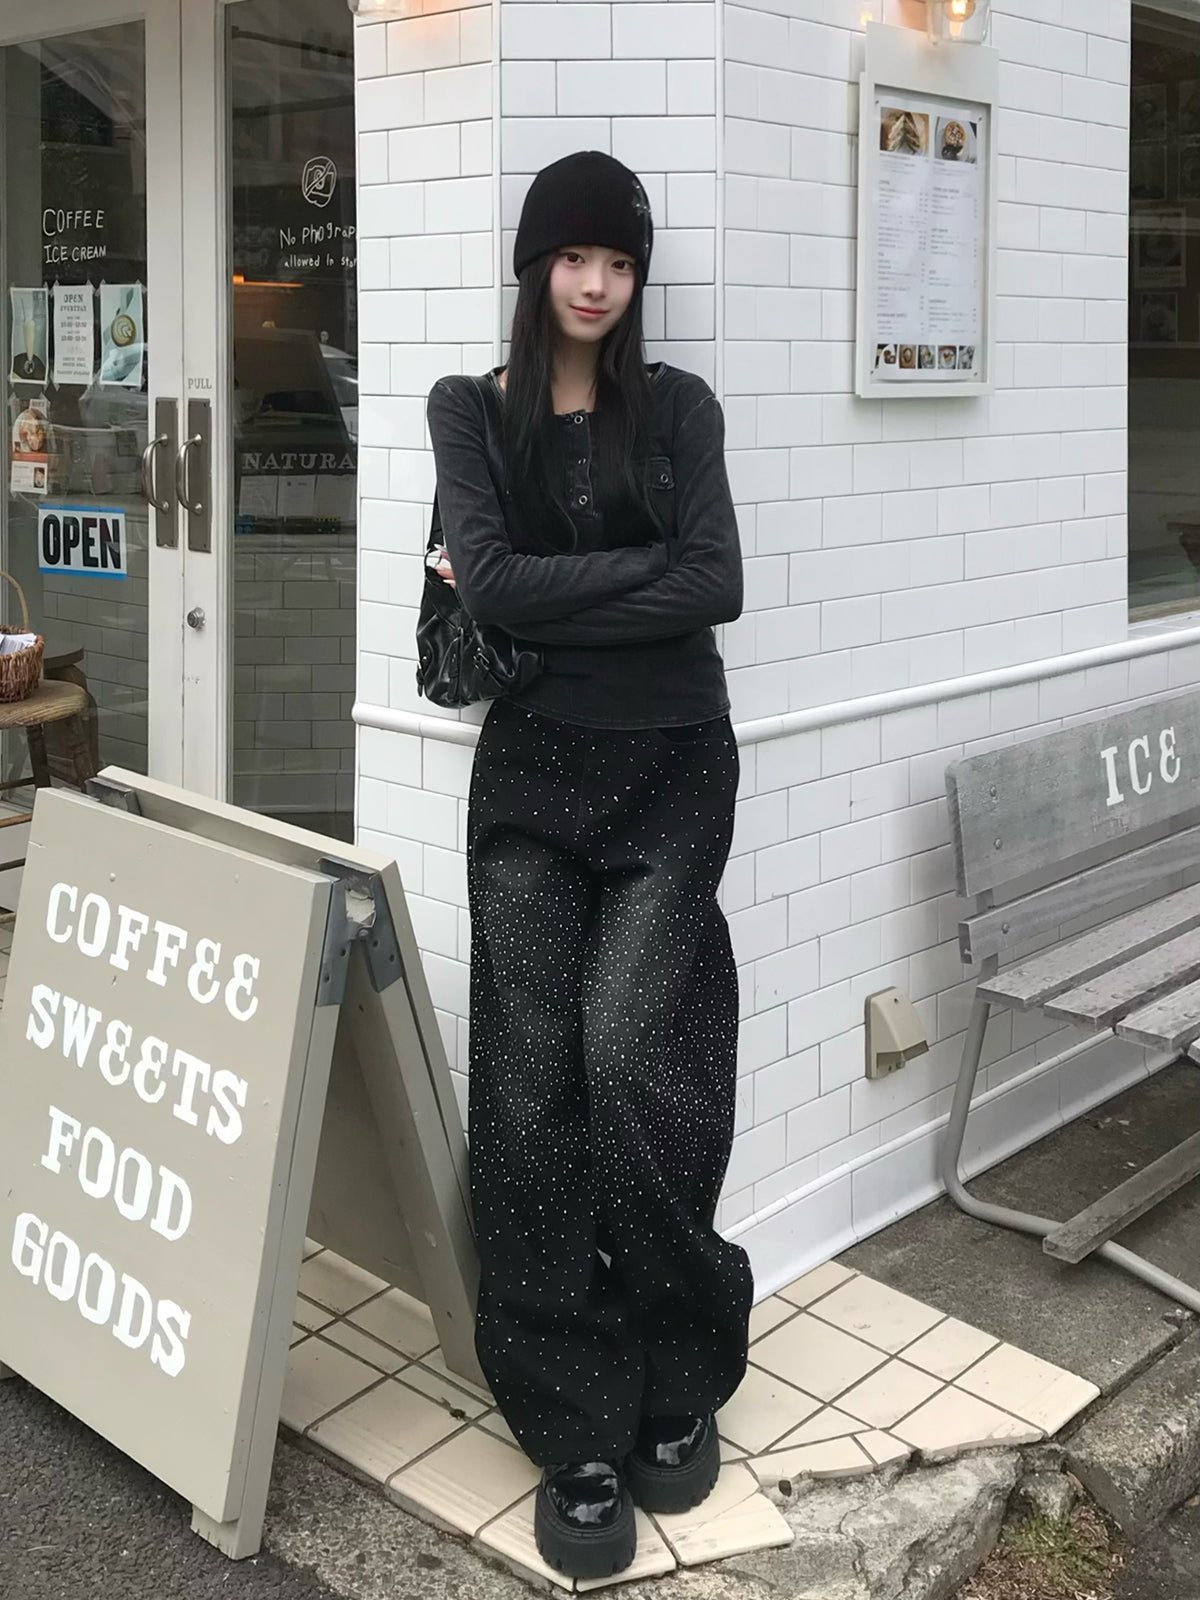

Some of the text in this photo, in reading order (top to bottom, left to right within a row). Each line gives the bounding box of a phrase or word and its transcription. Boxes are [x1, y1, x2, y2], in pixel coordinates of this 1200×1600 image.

[43, 208, 104, 236] COFFEE
[280, 227, 296, 248] No
[44, 244, 68, 263] ICE
[284, 254, 320, 268] allowed
[64, 294, 83, 303] OPEN
[188, 378, 212, 389] PULL
[242, 452, 356, 470] NATURA
[43, 514, 121, 569] OPEN
[1100, 726, 1181, 806] ICE
[46, 882, 260, 1022] COFFEE
[26, 983, 248, 1145] SWEETS
[41, 1105, 192, 1241] FOOD
[11, 1212, 191, 1377] GOODS
